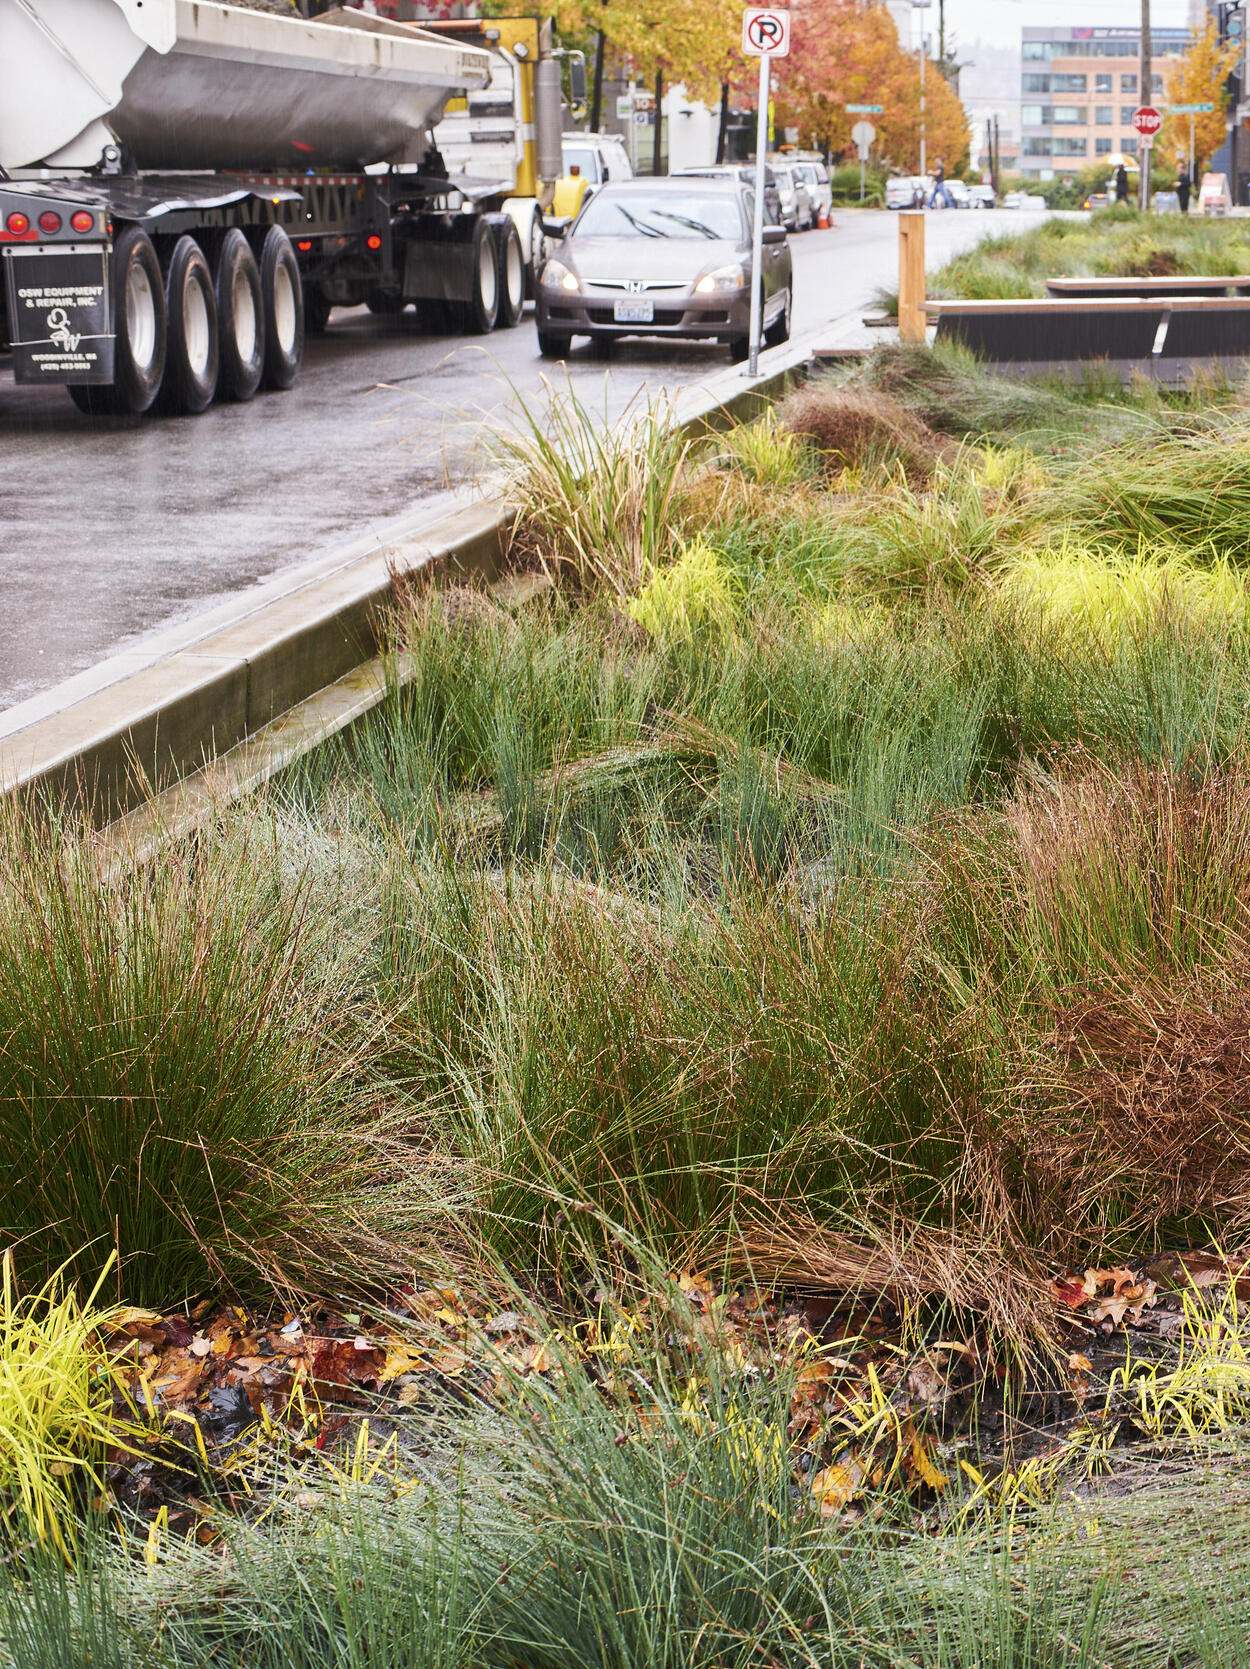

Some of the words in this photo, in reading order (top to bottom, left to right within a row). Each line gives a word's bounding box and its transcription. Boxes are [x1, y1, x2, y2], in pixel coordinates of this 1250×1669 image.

[1134, 115, 1160, 128] STOP
[18, 288, 43, 298] OSW
[43, 286, 104, 297] EQUIPMENT
[25, 298, 35, 308] &
[77, 296, 97, 307] INC.
